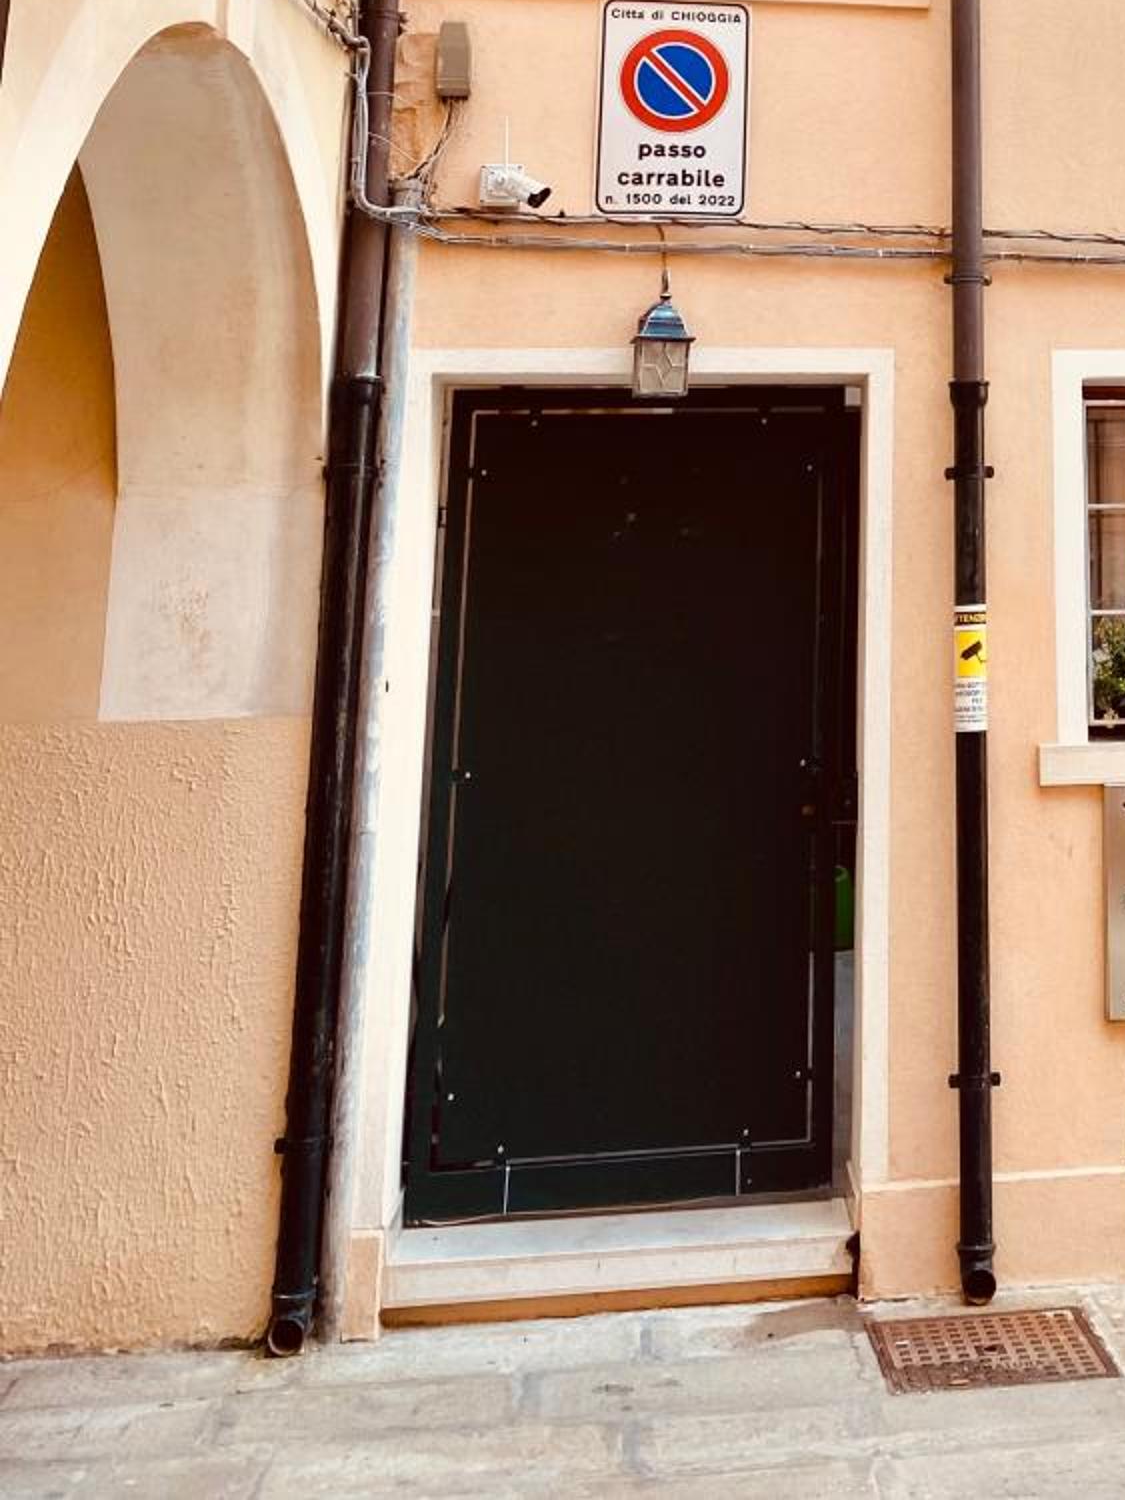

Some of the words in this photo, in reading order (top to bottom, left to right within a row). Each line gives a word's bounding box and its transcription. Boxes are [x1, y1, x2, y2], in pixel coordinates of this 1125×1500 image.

[651, 10, 664, 21] di
[671, 11, 741, 23] CHIOGGIA
[638, 143, 707, 160] passo
[617, 169, 725, 187] carrabile
[626, 193, 662, 205] 1500
[669, 193, 691, 205] del
[699, 195, 735, 207] 2022
